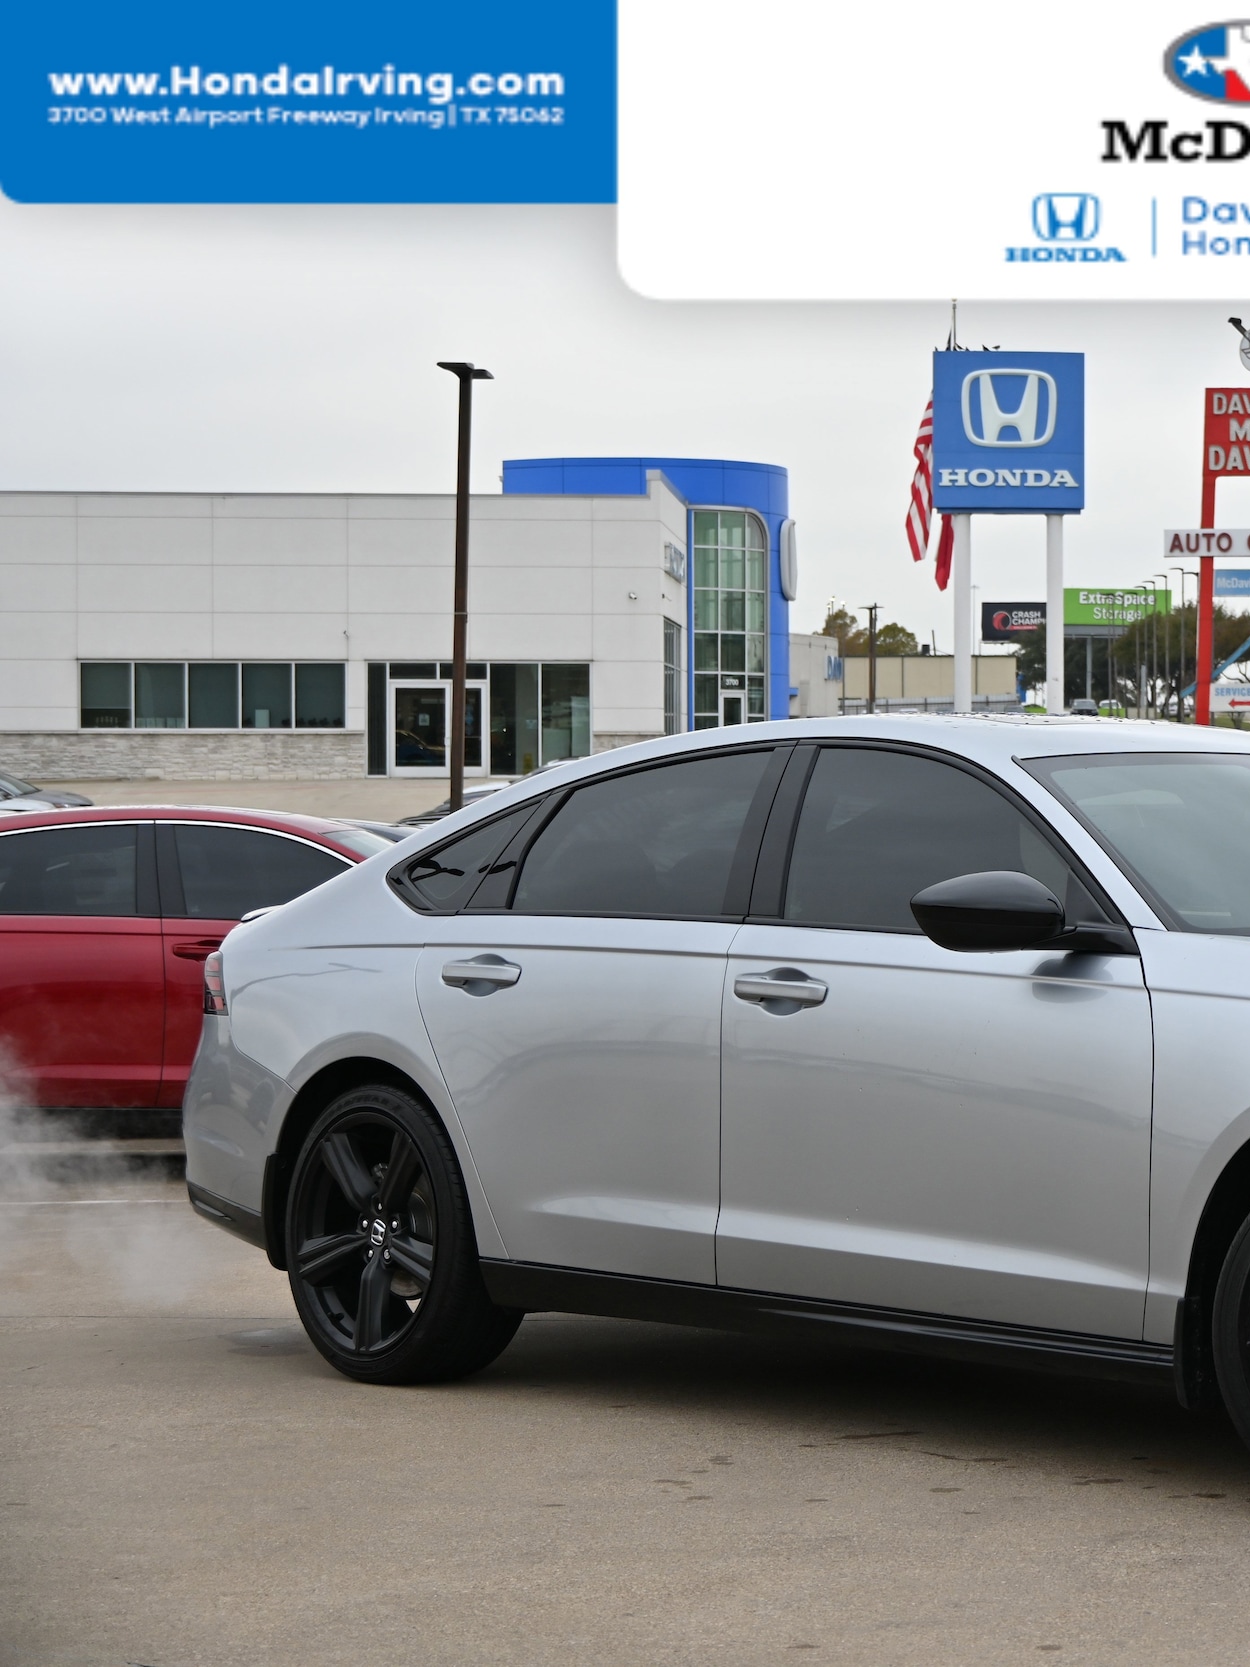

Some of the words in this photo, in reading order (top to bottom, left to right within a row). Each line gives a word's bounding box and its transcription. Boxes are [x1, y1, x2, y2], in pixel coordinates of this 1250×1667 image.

[938, 469, 1079, 487] HONDA
[1169, 532, 1233, 553] AUTO
[1011, 611, 1041, 619] CRASH
